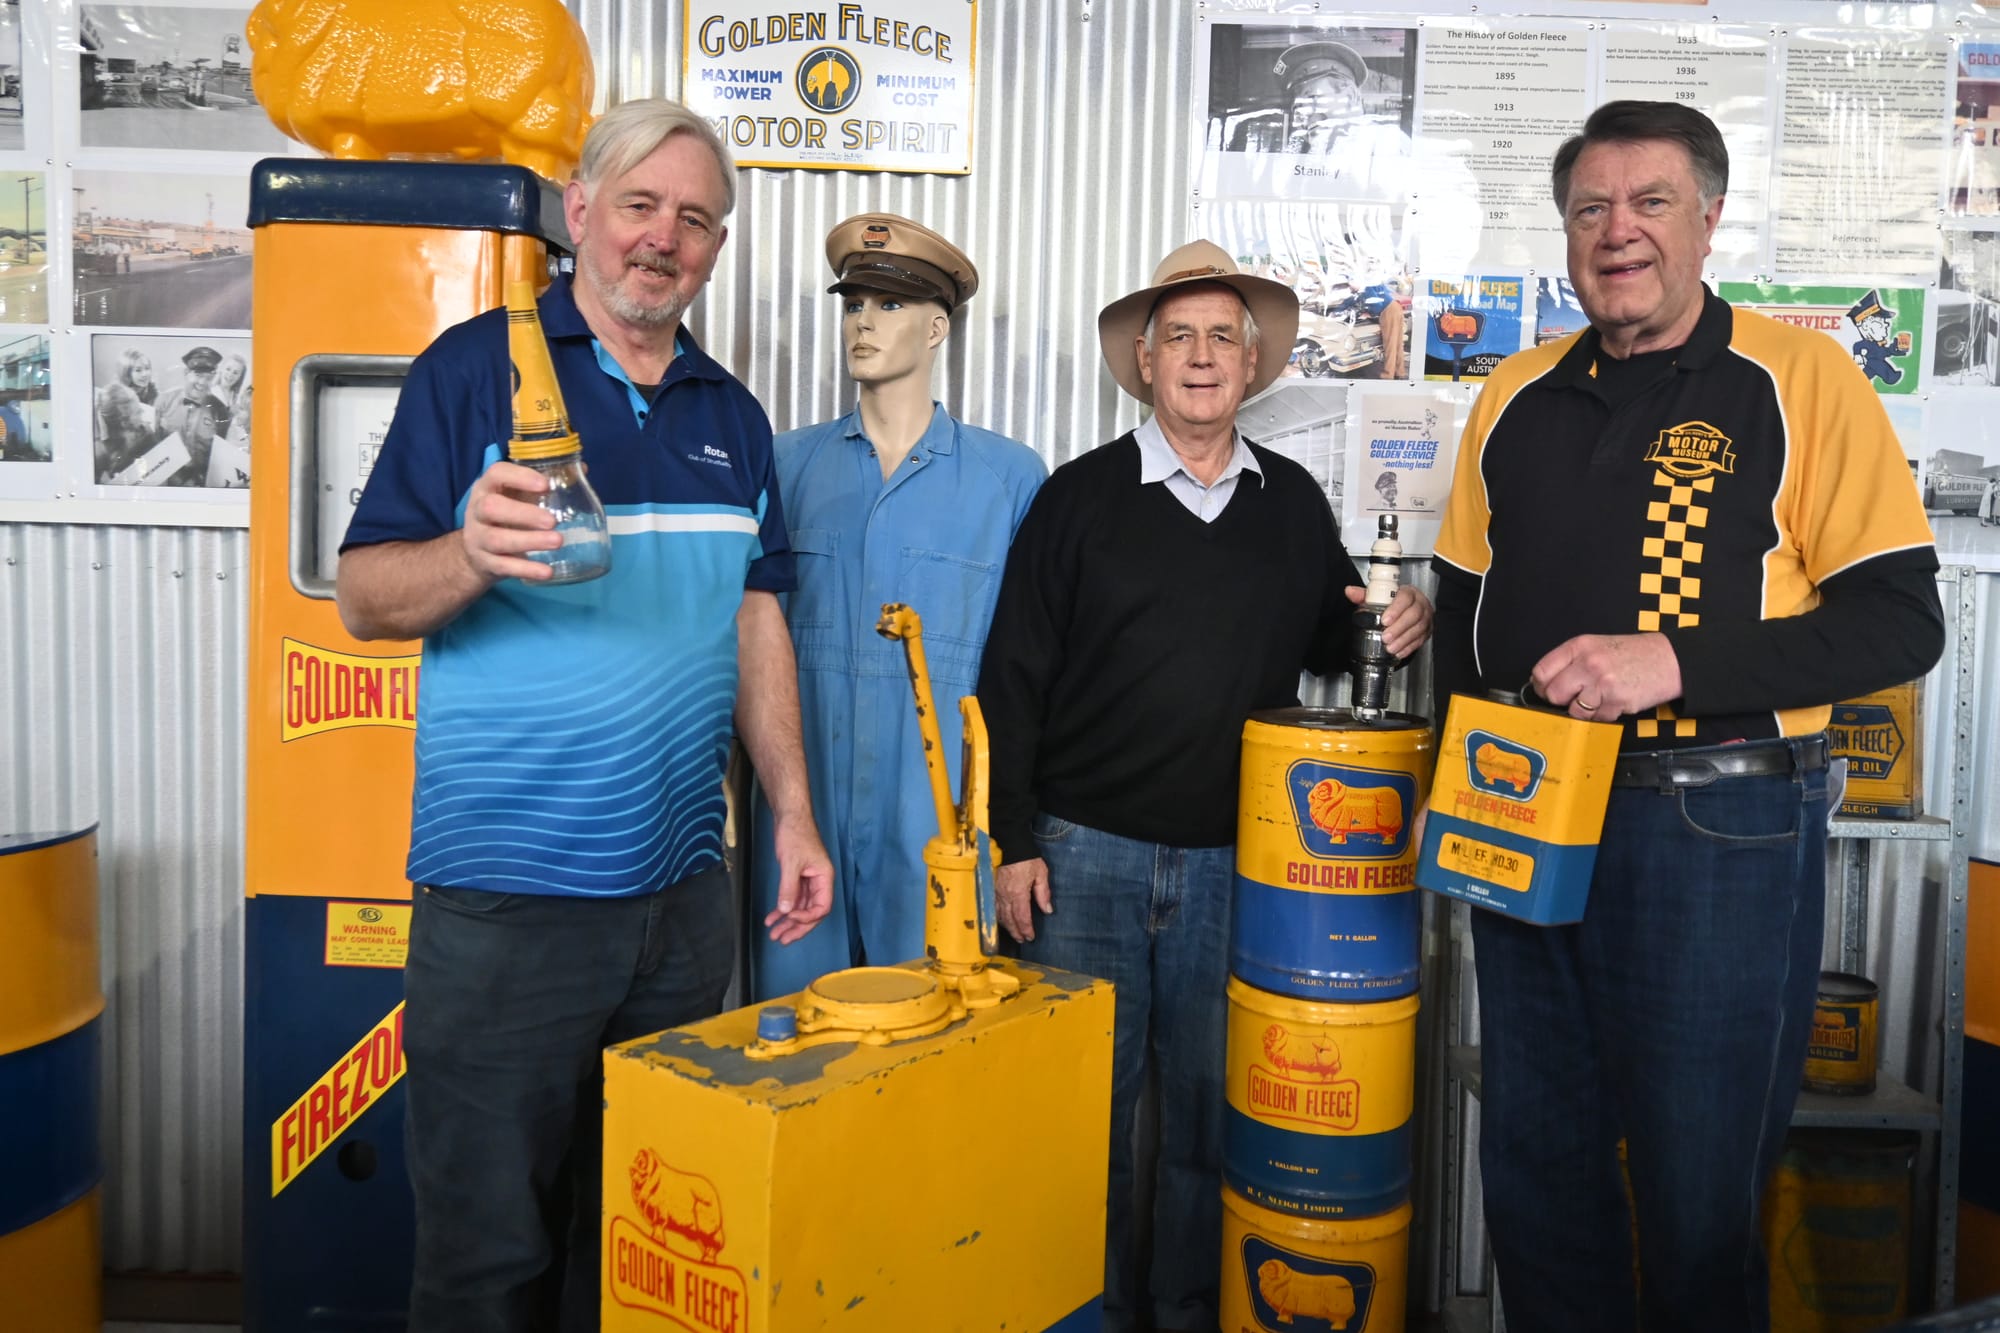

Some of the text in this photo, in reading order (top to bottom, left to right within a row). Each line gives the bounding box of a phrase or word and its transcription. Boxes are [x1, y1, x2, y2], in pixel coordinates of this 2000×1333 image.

[699, 3, 953, 63] GOLDEN FLEECE
[1448, 30, 1567, 41] The History of Golden Fleece
[702, 69, 783, 84] MAXIMUM
[1496, 72, 1516, 80] 1895
[1676, 67, 1696, 75] 1936
[877, 74, 955, 91] MINIMUM
[713, 86, 771, 101] POWER
[892, 92, 939, 107] COST
[708, 115, 957, 153] MOTOR SPIRIT
[1492, 140, 1512, 148] 1920
[1489, 211, 1508, 220] 1929
[1480, 281, 1519, 296] FLEECE
[1496, 299, 1518, 312] Map
[536, 399, 551, 412] 30
[1370, 440, 1439, 451] GOLDEN FLEECE
[1668, 436, 1719, 452] MOTOR
[1370, 450, 1436, 460] GOLDEN SERVICE
[1672, 448, 1710, 460] MUSEUM
[1382, 460, 1434, 471] -nothing less!
[1938, 482, 1970, 492] GOLDEN
[287, 651, 383, 729] GOLDEN
[1853, 728, 1895, 756] FLEECE
[1862, 762, 1882, 772] OIL
[1456, 789, 1538, 825] GOLDEN FLEECE
[1842, 806, 1878, 814] SLEIGH
[1288, 862, 1414, 889] GOLDEN FLEECE
[343, 924, 396, 936] WARNING
[350, 936, 384, 944] CONTAIN
[1290, 976, 1324, 987] GOLDEN
[1329, 980, 1359, 988] FLEECE
[1252, 1076, 1352, 1118] GOLDEN FLEECE
[1275, 1162, 1303, 1172] GALLONS
[1304, 1202, 1344, 1213] LIMITED
[618, 1237, 739, 1333] GOLDEN FLEECE
